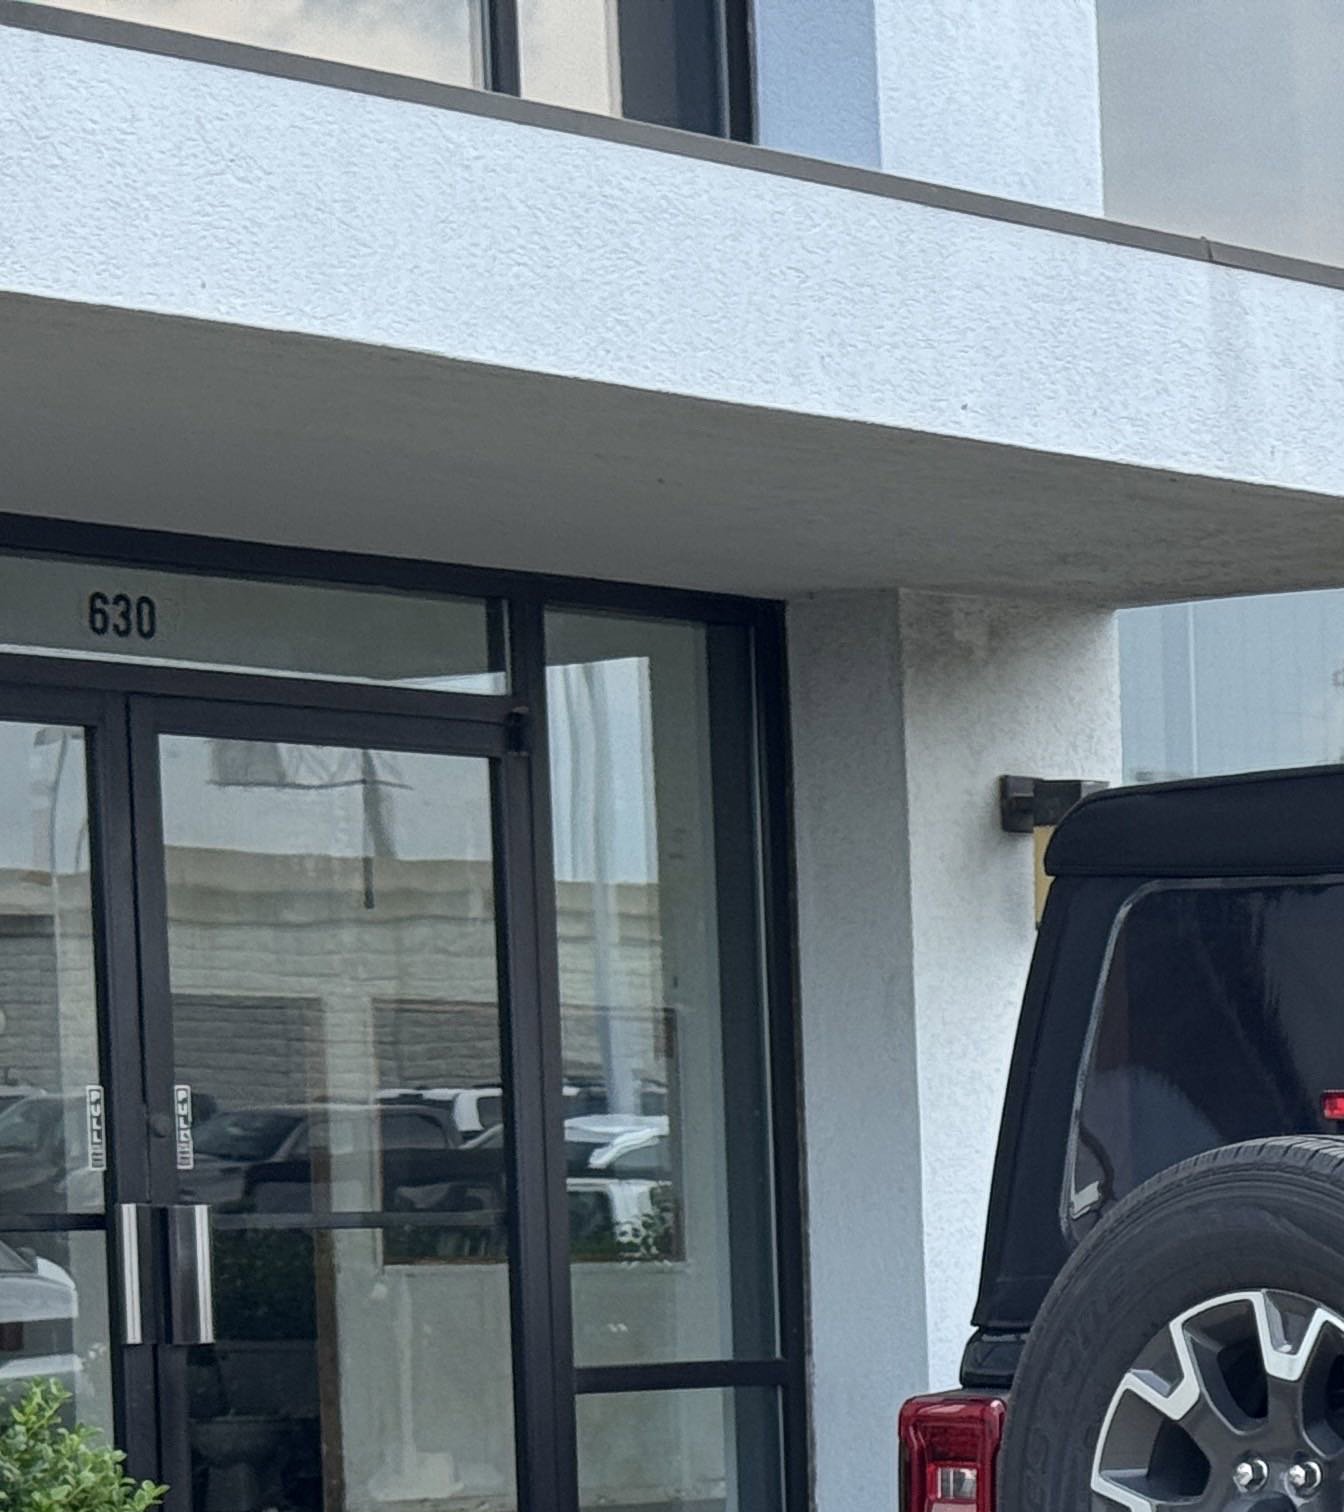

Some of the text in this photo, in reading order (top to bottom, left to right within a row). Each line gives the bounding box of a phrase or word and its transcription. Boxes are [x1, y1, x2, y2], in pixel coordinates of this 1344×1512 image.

[88, 591, 156, 640] 630
[90, 1090, 102, 1143] PULL
[177, 1090, 190, 1142] PULL
